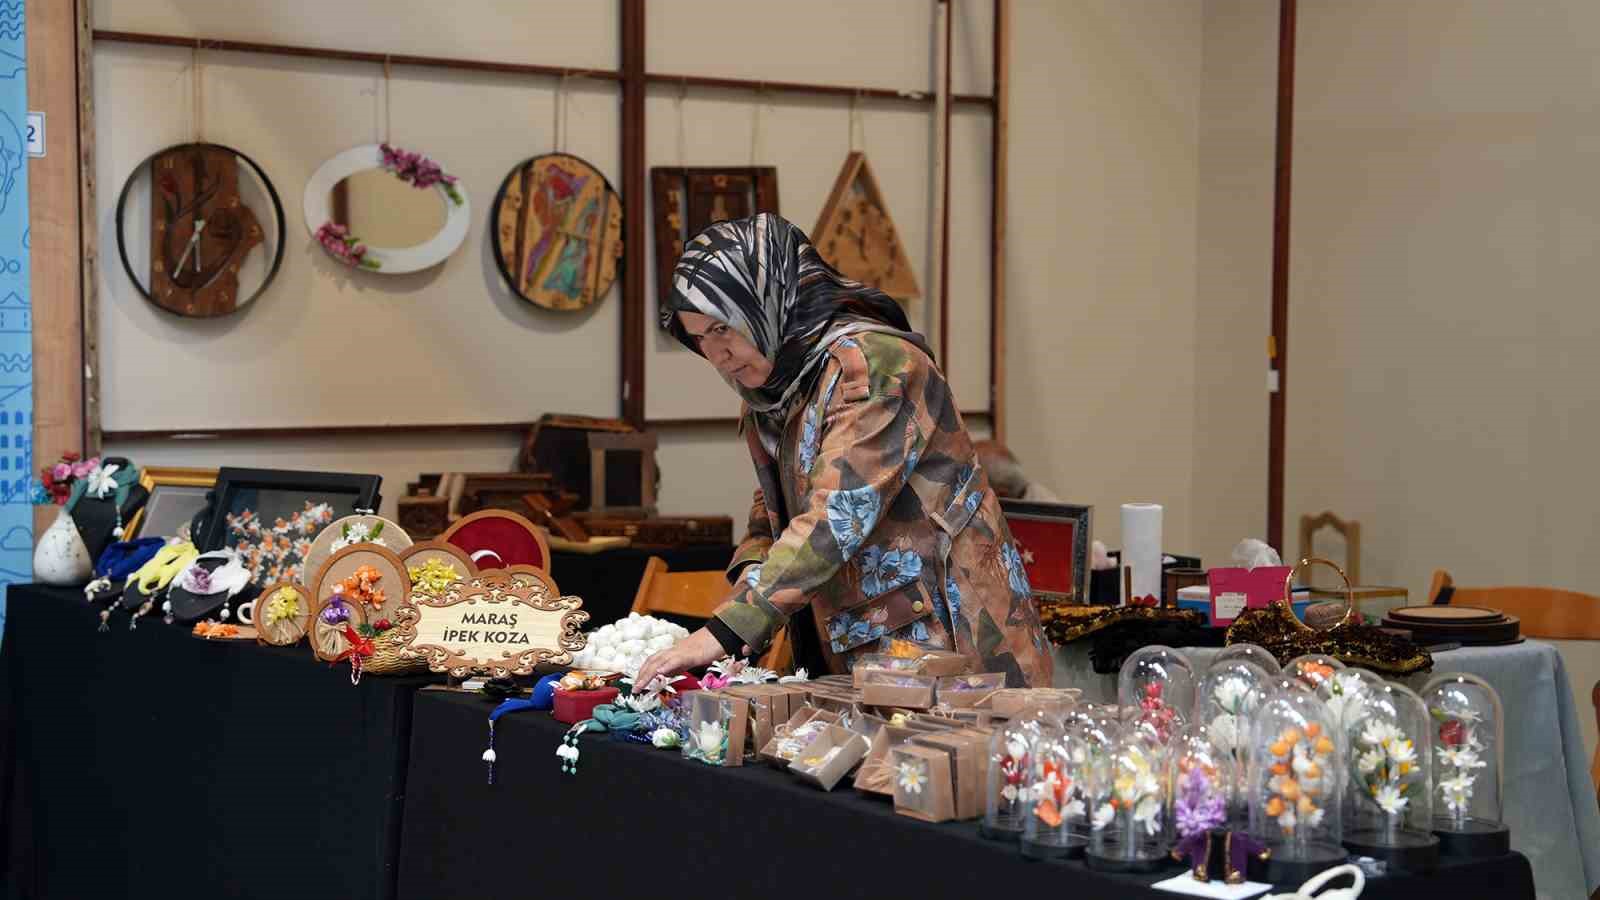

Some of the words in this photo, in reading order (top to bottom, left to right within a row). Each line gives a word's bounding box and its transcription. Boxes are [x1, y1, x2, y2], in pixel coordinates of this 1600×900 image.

[461, 613, 518, 629] MARAŞ
[443, 626, 479, 642] İPEK
[484, 631, 530, 645] KOZA
